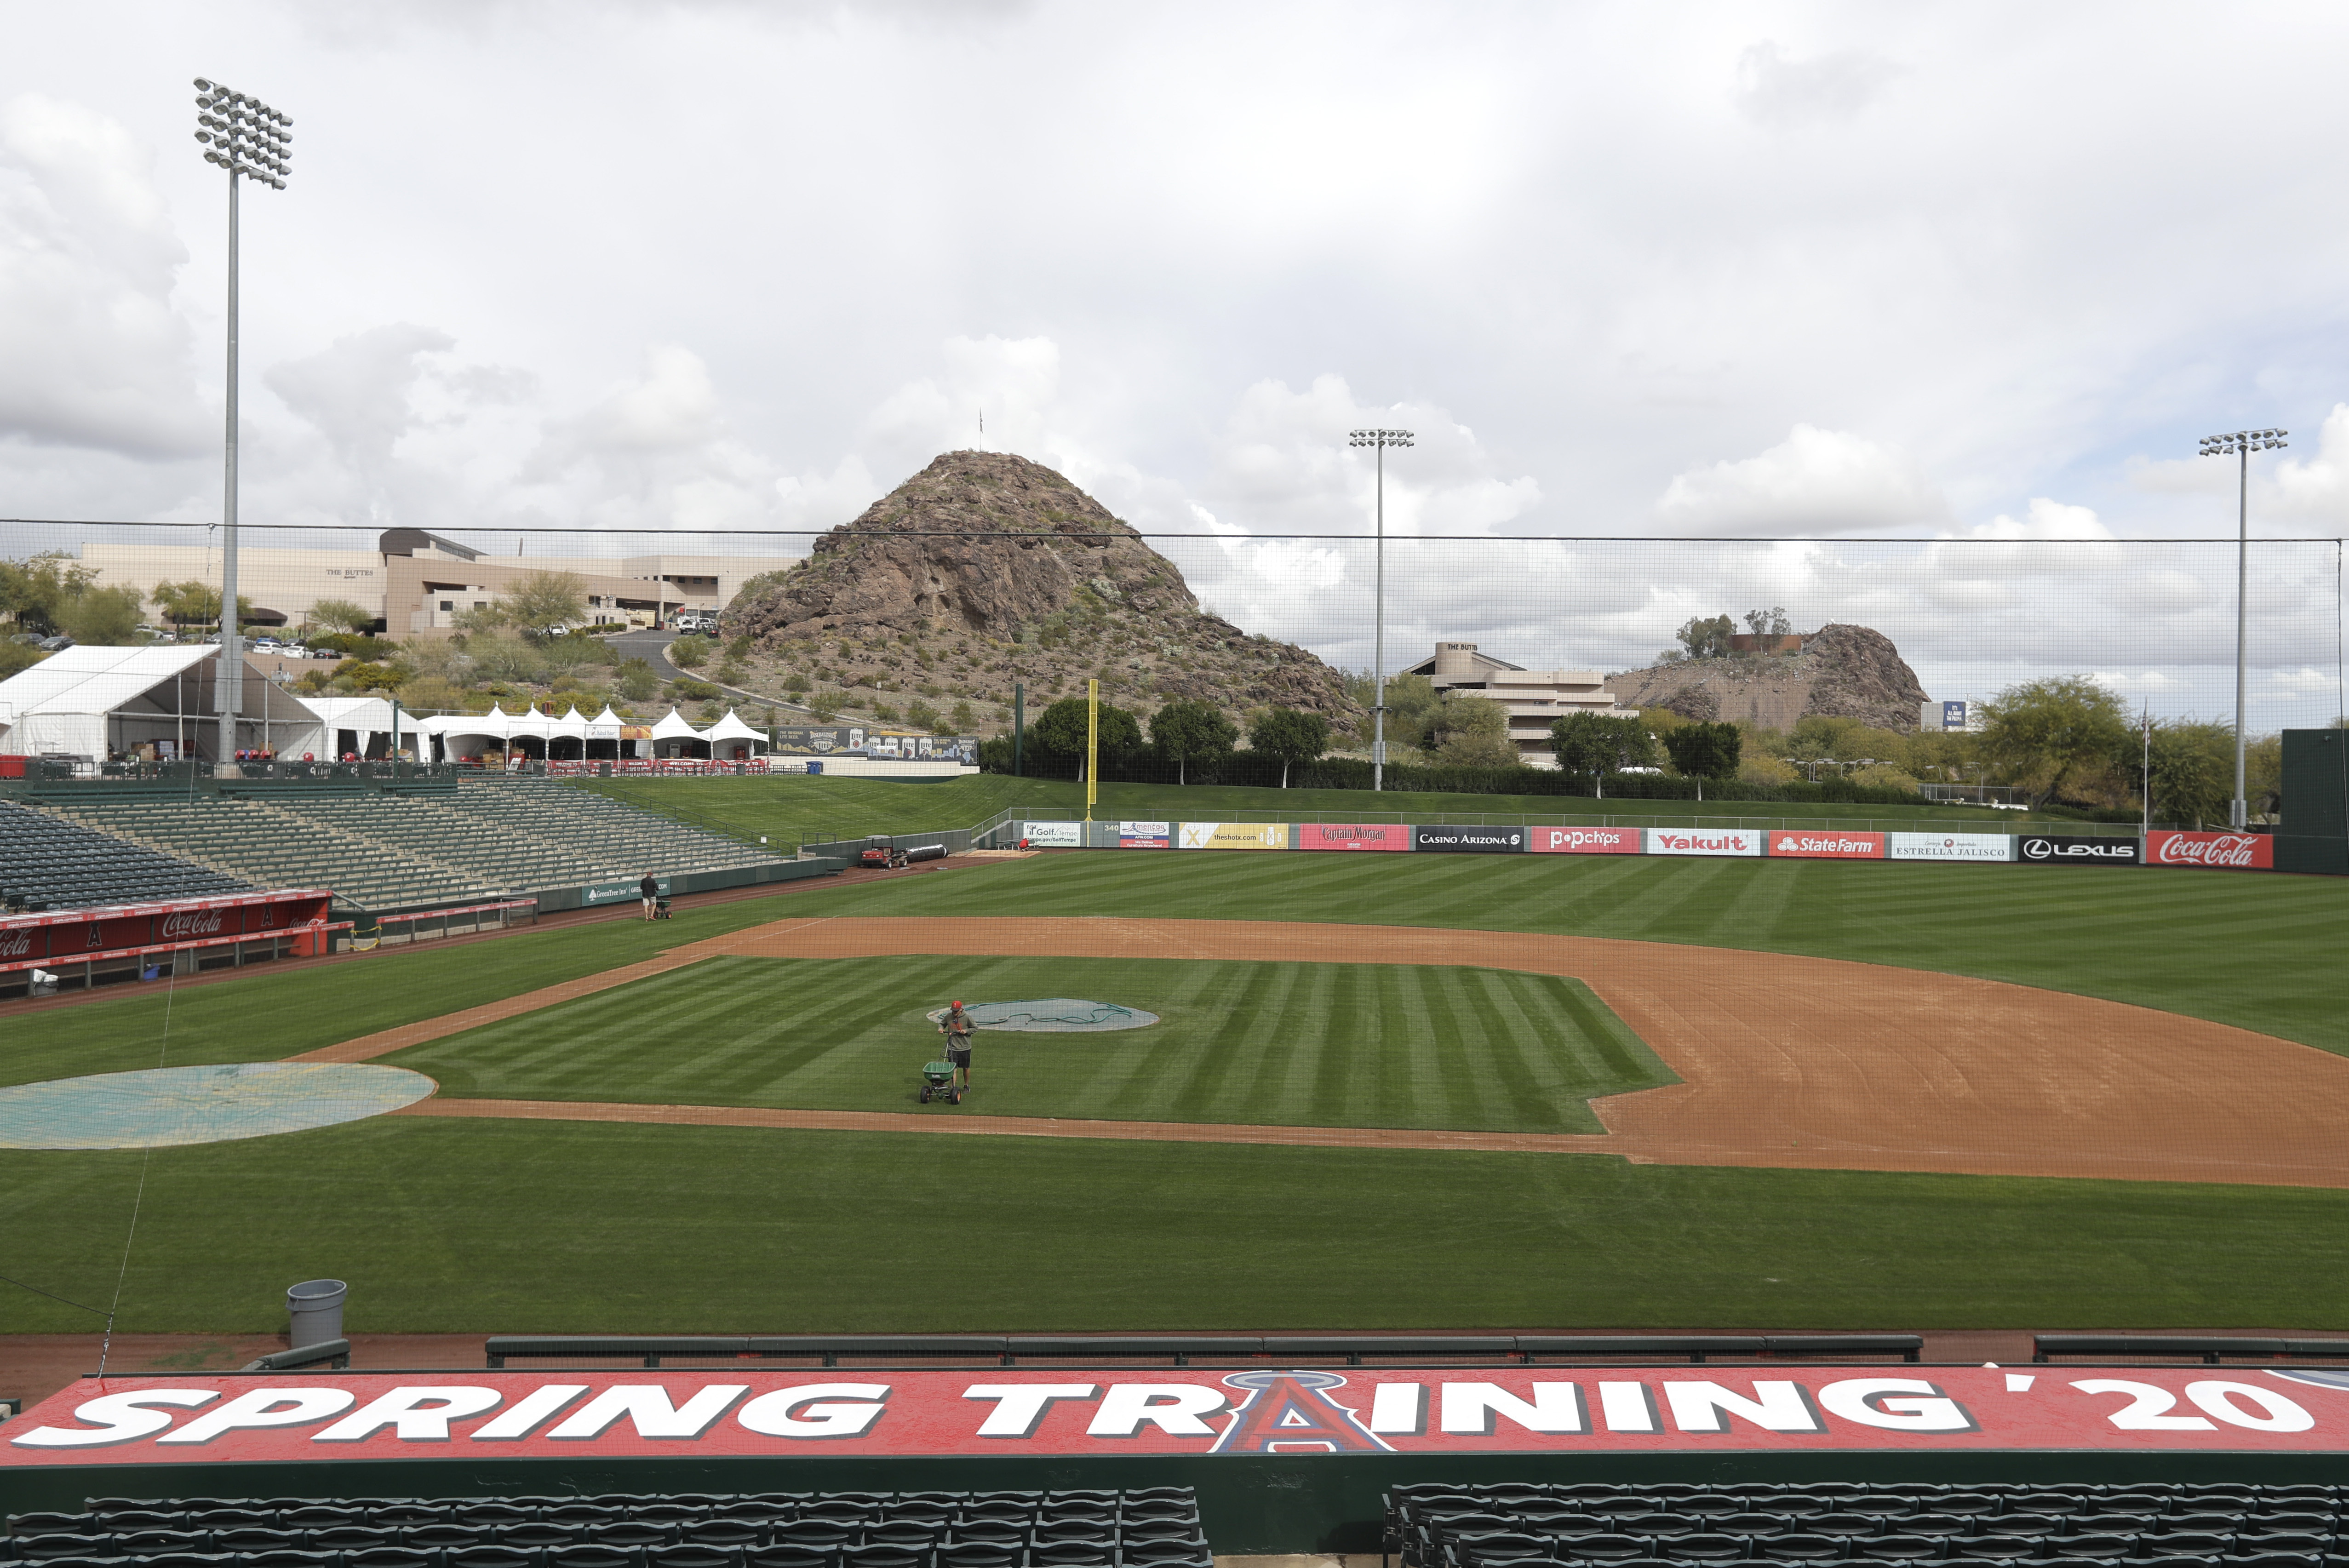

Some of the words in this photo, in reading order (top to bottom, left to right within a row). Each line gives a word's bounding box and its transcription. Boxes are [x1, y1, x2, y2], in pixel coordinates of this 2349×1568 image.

[1322, 825, 1352, 842] Captain
[1352, 826, 1386, 842] Morgan
[1550, 830, 1620, 849] popchips
[1657, 835, 1747, 851] Yakult
[1896, 847, 1953, 855] ESTRELLA
[2054, 844, 2134, 857] LEXUS
[2160, 834, 2259, 865] Coca-Cola
[10, 1383, 891, 1446] SPRING
[961, 1371, 1971, 1452] TRAINING
